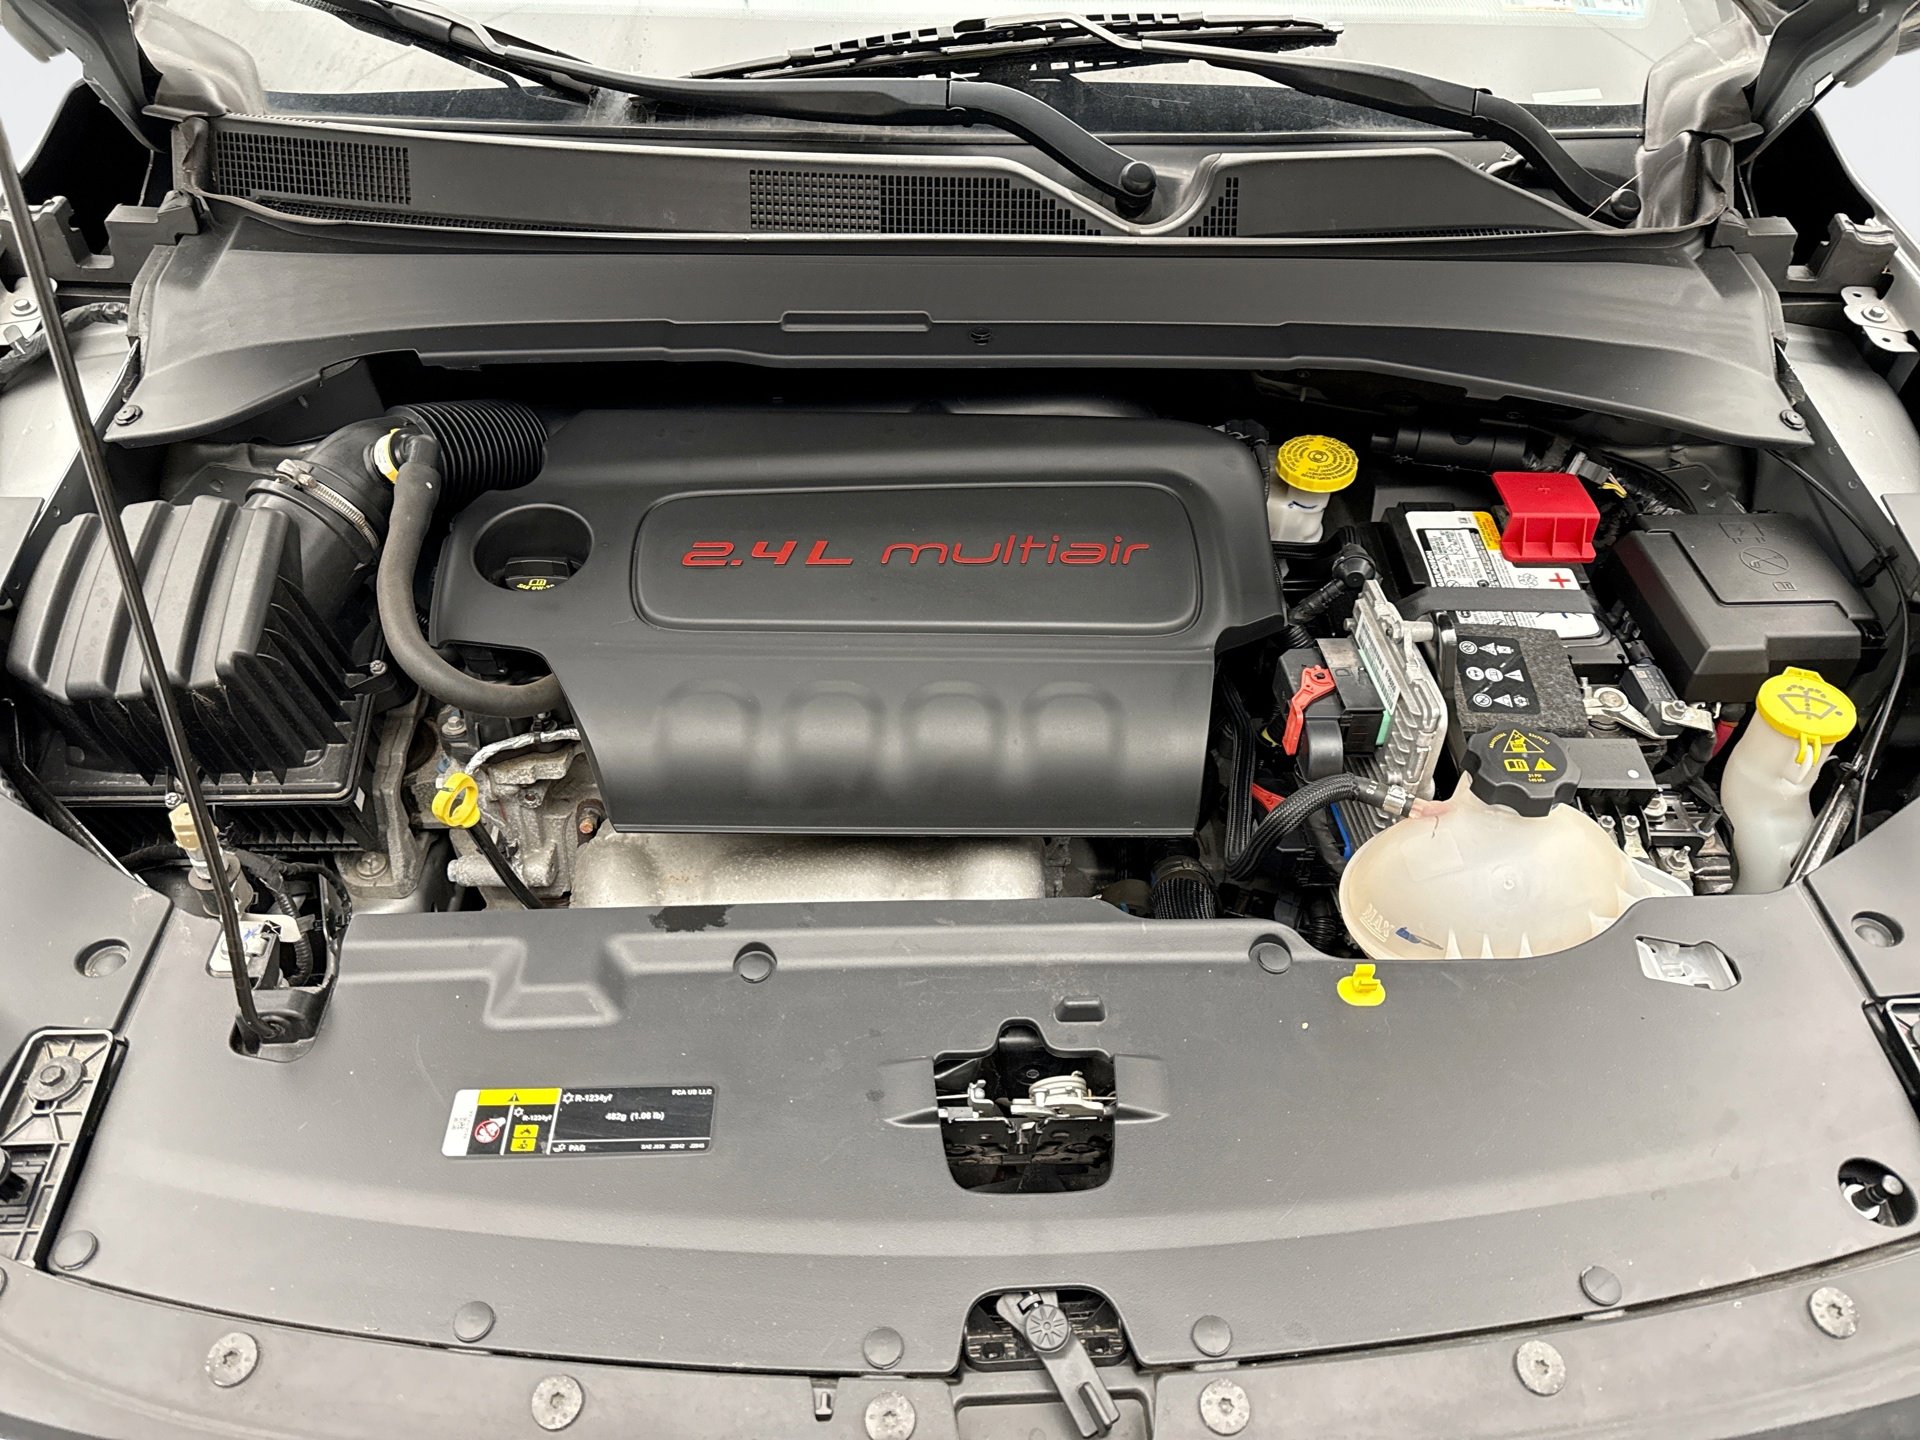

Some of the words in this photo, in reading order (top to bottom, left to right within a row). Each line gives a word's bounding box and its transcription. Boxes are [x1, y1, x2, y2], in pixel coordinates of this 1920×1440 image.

[881, 534, 1150, 566] multiair
[574, 1093, 613, 1104] R-1234yf
[521, 1114, 552, 1122] R-1234yf
[568, 1144, 586, 1152] PAG
